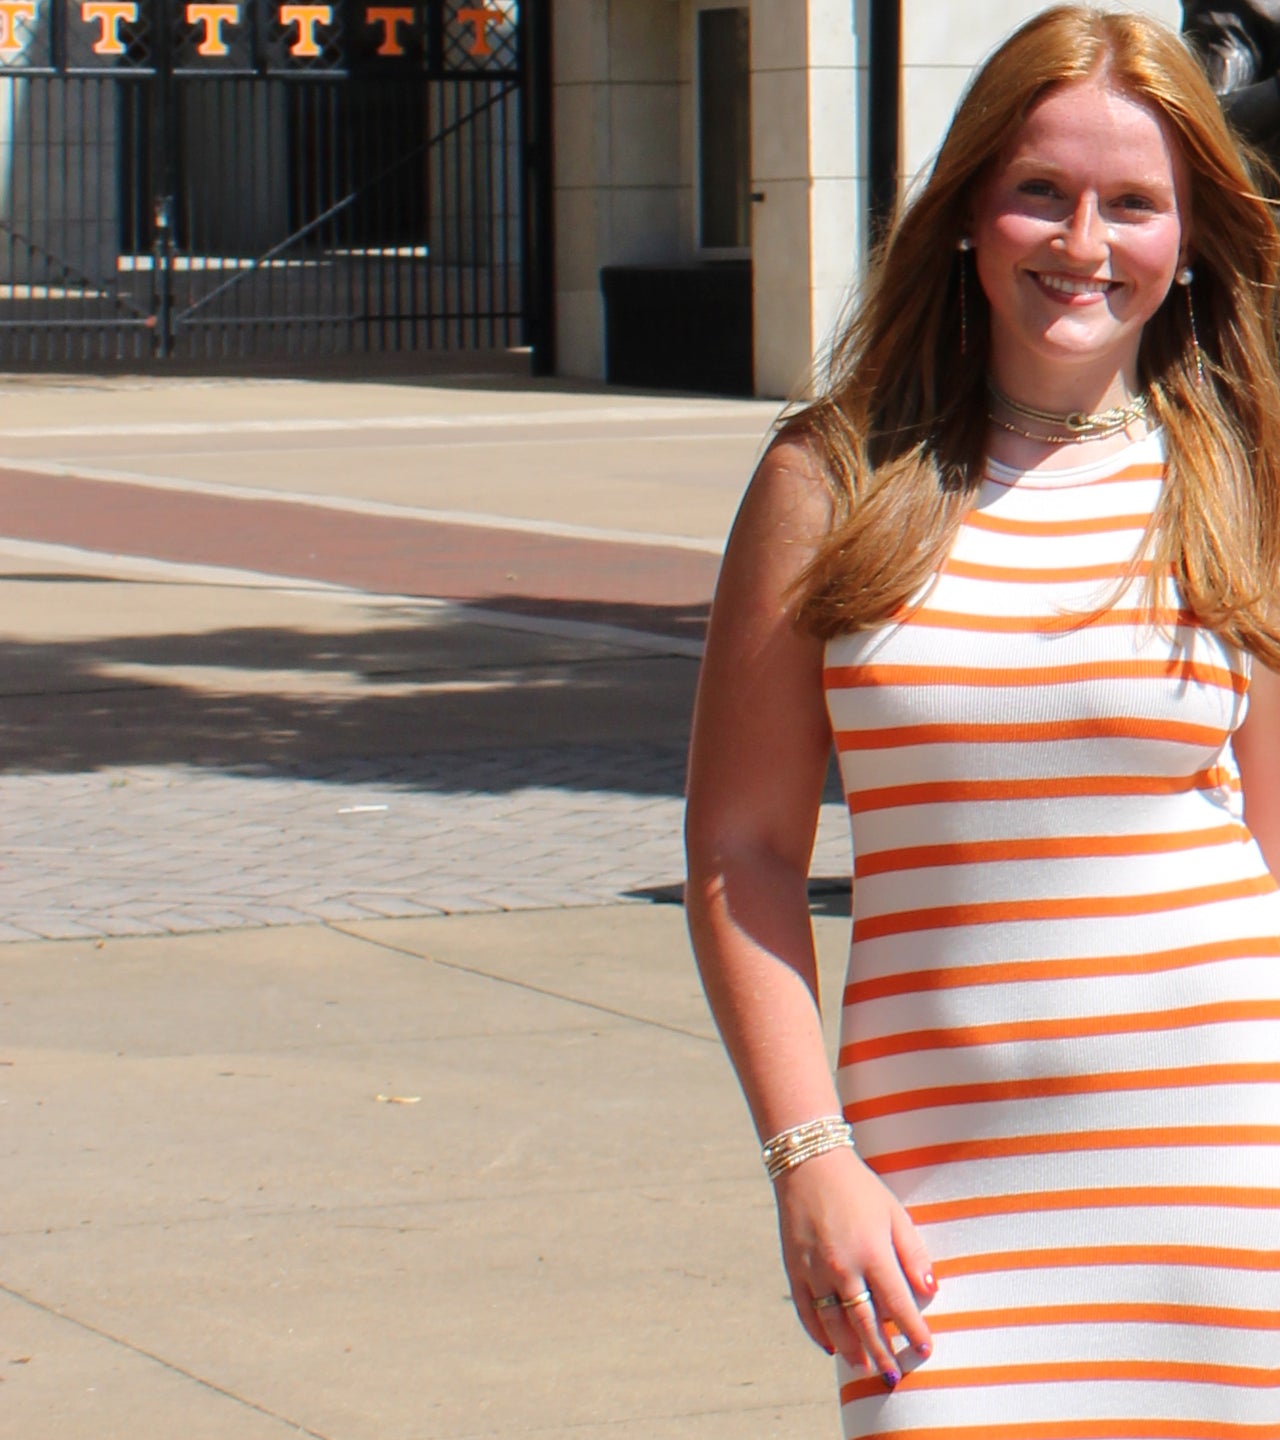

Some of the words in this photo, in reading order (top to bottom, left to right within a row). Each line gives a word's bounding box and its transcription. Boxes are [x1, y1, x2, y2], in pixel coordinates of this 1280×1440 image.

[81, 1, 138, 55] T
[186, 3, 240, 56] T
[280, 4, 333, 57] T
[365, 7, 414, 56] T
[456, 8, 504, 56] T
